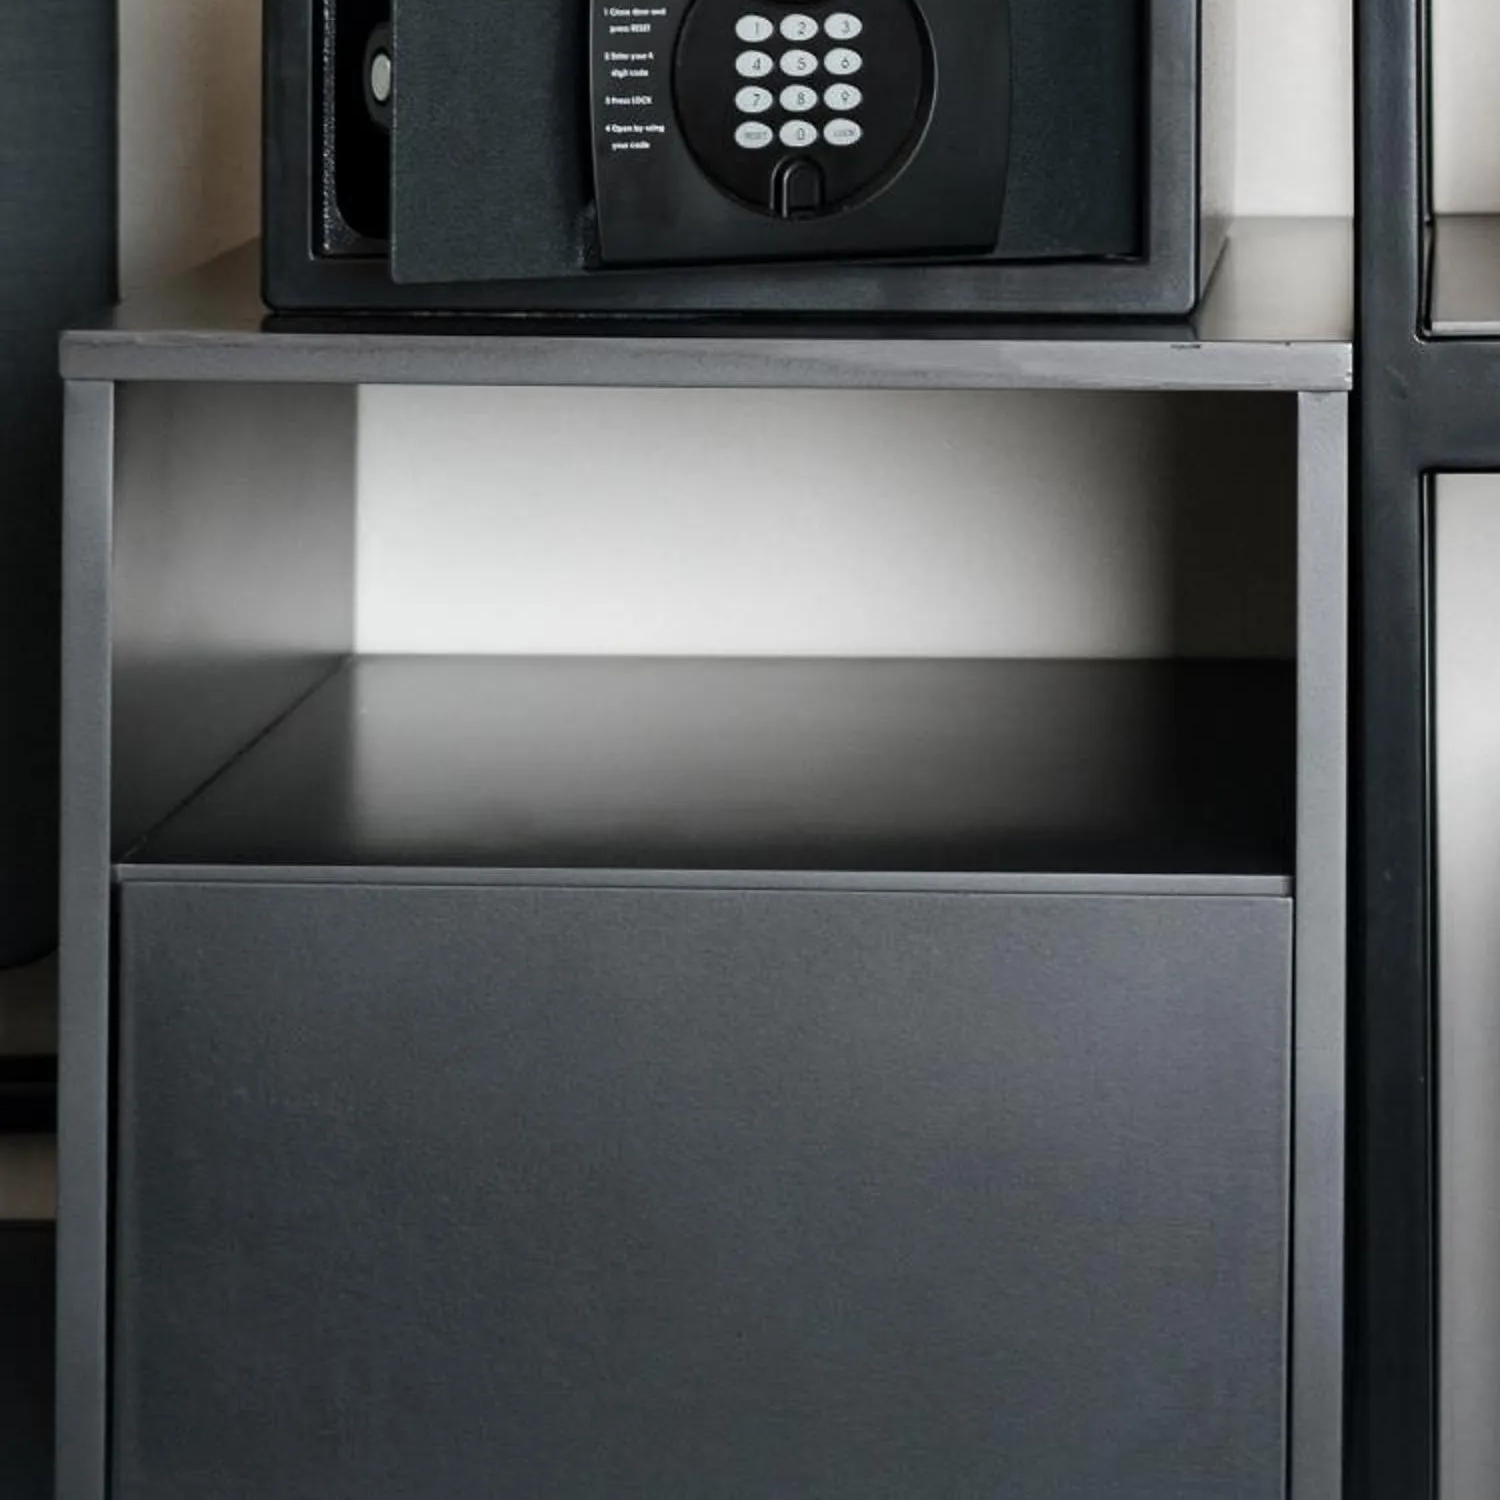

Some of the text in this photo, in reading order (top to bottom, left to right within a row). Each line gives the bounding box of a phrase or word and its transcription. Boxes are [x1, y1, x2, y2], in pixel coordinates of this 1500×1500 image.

[797, 20, 806, 35] 2
[841, 20, 850, 34] 3
[752, 55, 850, 71] 4 5 6
[753, 90, 850, 107] 7 8 9
[797, 127, 805, 141] 0
